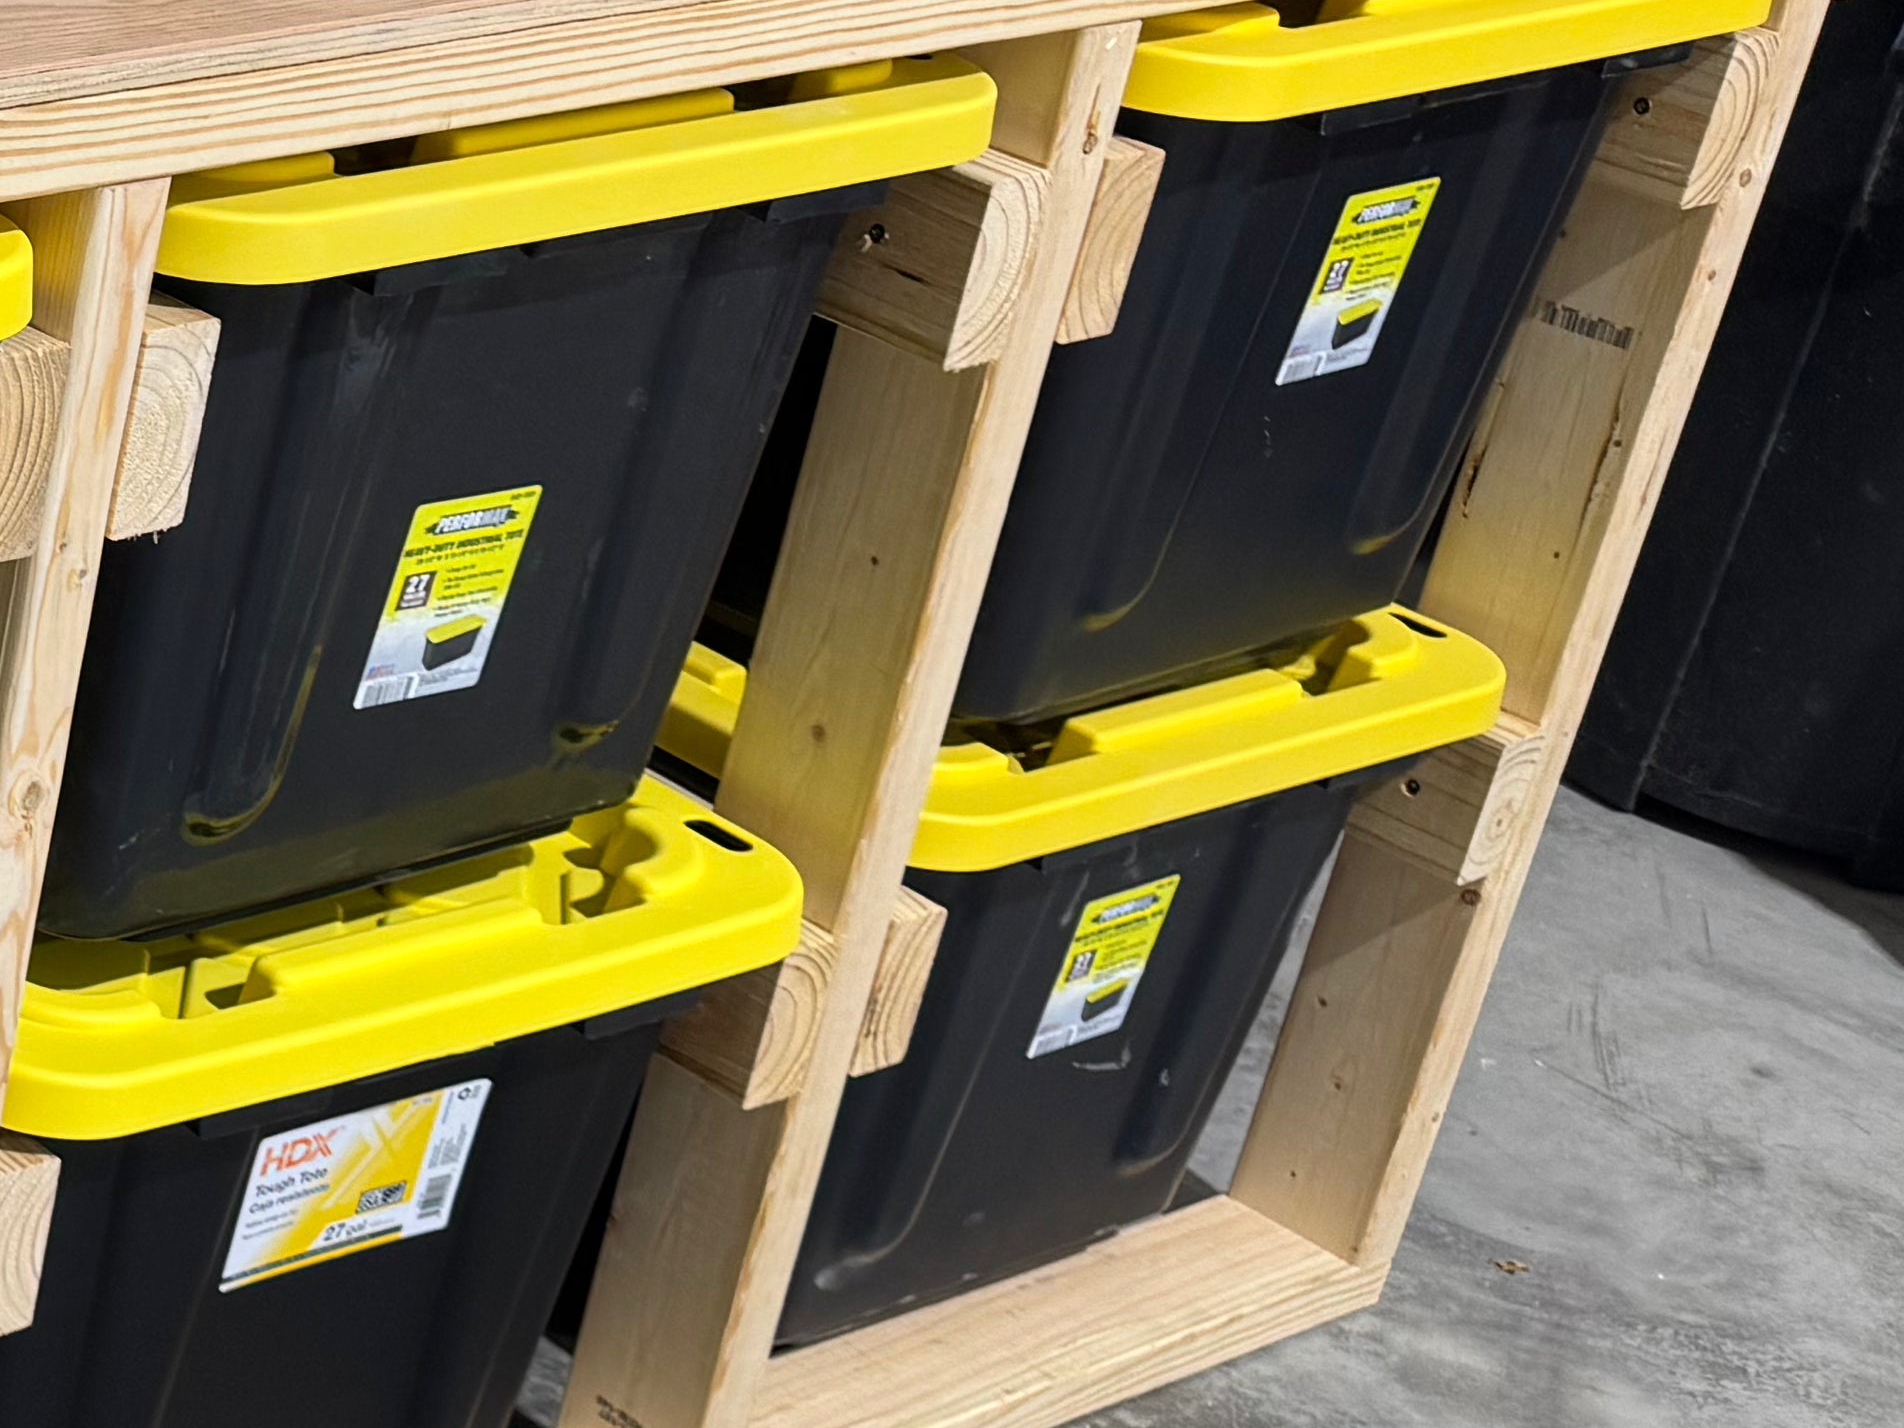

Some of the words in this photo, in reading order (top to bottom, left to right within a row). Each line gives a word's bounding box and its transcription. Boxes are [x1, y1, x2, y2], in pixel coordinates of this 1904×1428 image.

[405, 573, 430, 594] 27
[259, 1128, 337, 1176] HDX
[323, 1222, 345, 1241] 27
